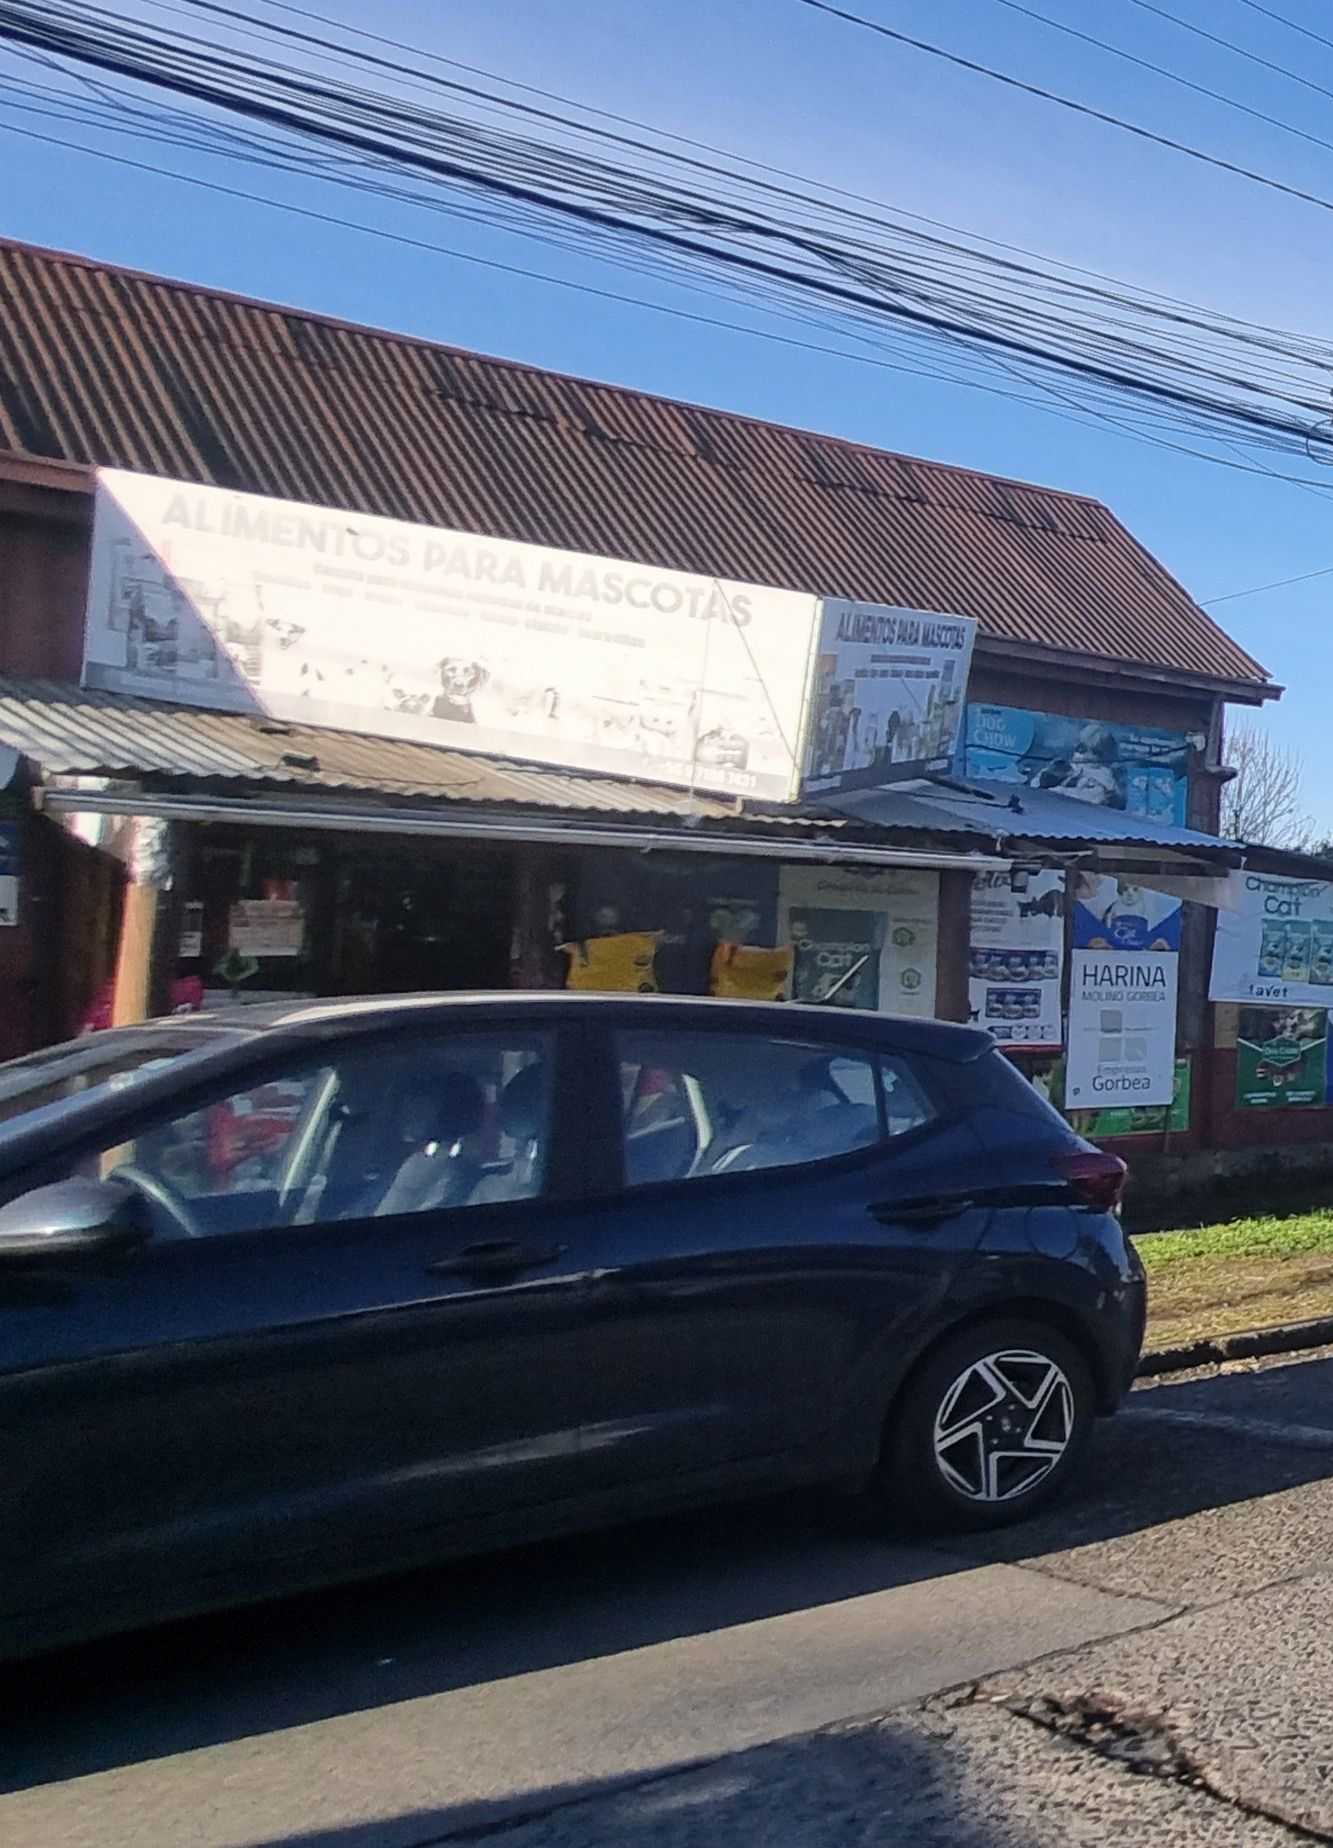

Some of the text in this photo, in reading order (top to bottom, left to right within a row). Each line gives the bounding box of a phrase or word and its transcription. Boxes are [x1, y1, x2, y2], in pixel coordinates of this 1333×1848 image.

[162, 492, 410, 568] ALIMENTOS
[423, 544, 527, 590] PARA
[538, 558, 753, 628] MASCOTAS
[836, 612, 897, 645] ALIMENTOS
[921, 622, 966, 650] MASCOTAS
[1264, 896, 1302, 916] Cat
[1082, 964, 1166, 987] HARINA
[1092, 1075, 1151, 1091] Gorbea
